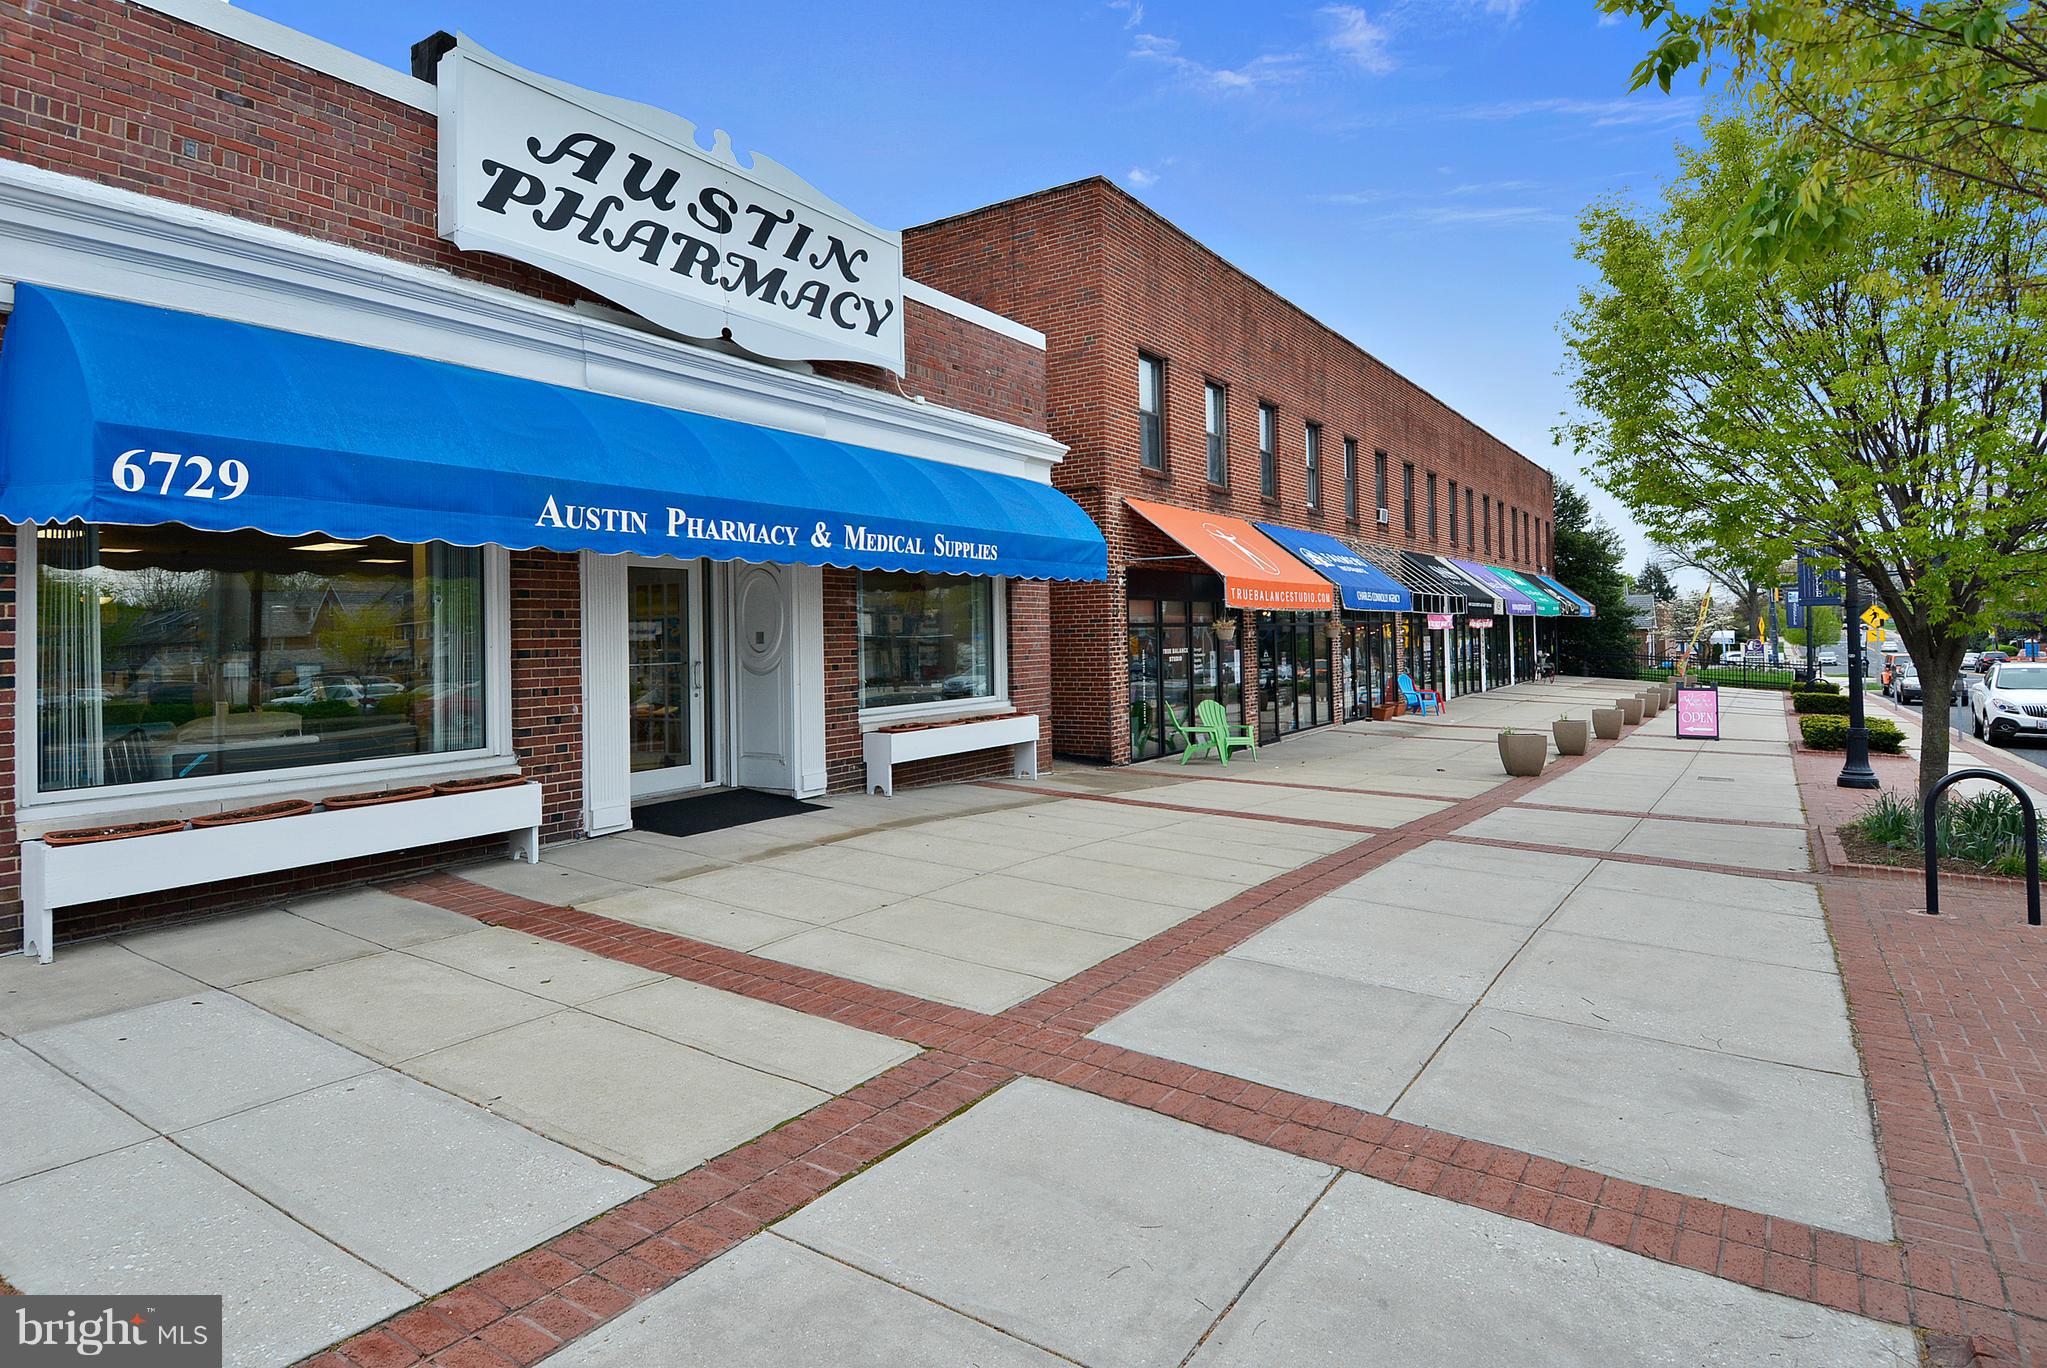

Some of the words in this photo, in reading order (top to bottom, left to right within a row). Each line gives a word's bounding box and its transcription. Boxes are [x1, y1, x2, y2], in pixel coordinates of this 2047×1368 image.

[526, 132, 868, 283] AUSTIN
[476, 158, 894, 338] PHARMACY
[112, 449, 249, 501] 6729
[534, 494, 648, 535] AUSTIN
[666, 507, 799, 546] PHARMACY
[810, 521, 832, 548] &
[844, 524, 925, 555] MEDICAL
[934, 533, 998, 561] SUPPLIES
[1231, 587, 1331, 603] TRUEBALANCESTUDIO.COM
[1681, 711, 1714, 723] OPEN
